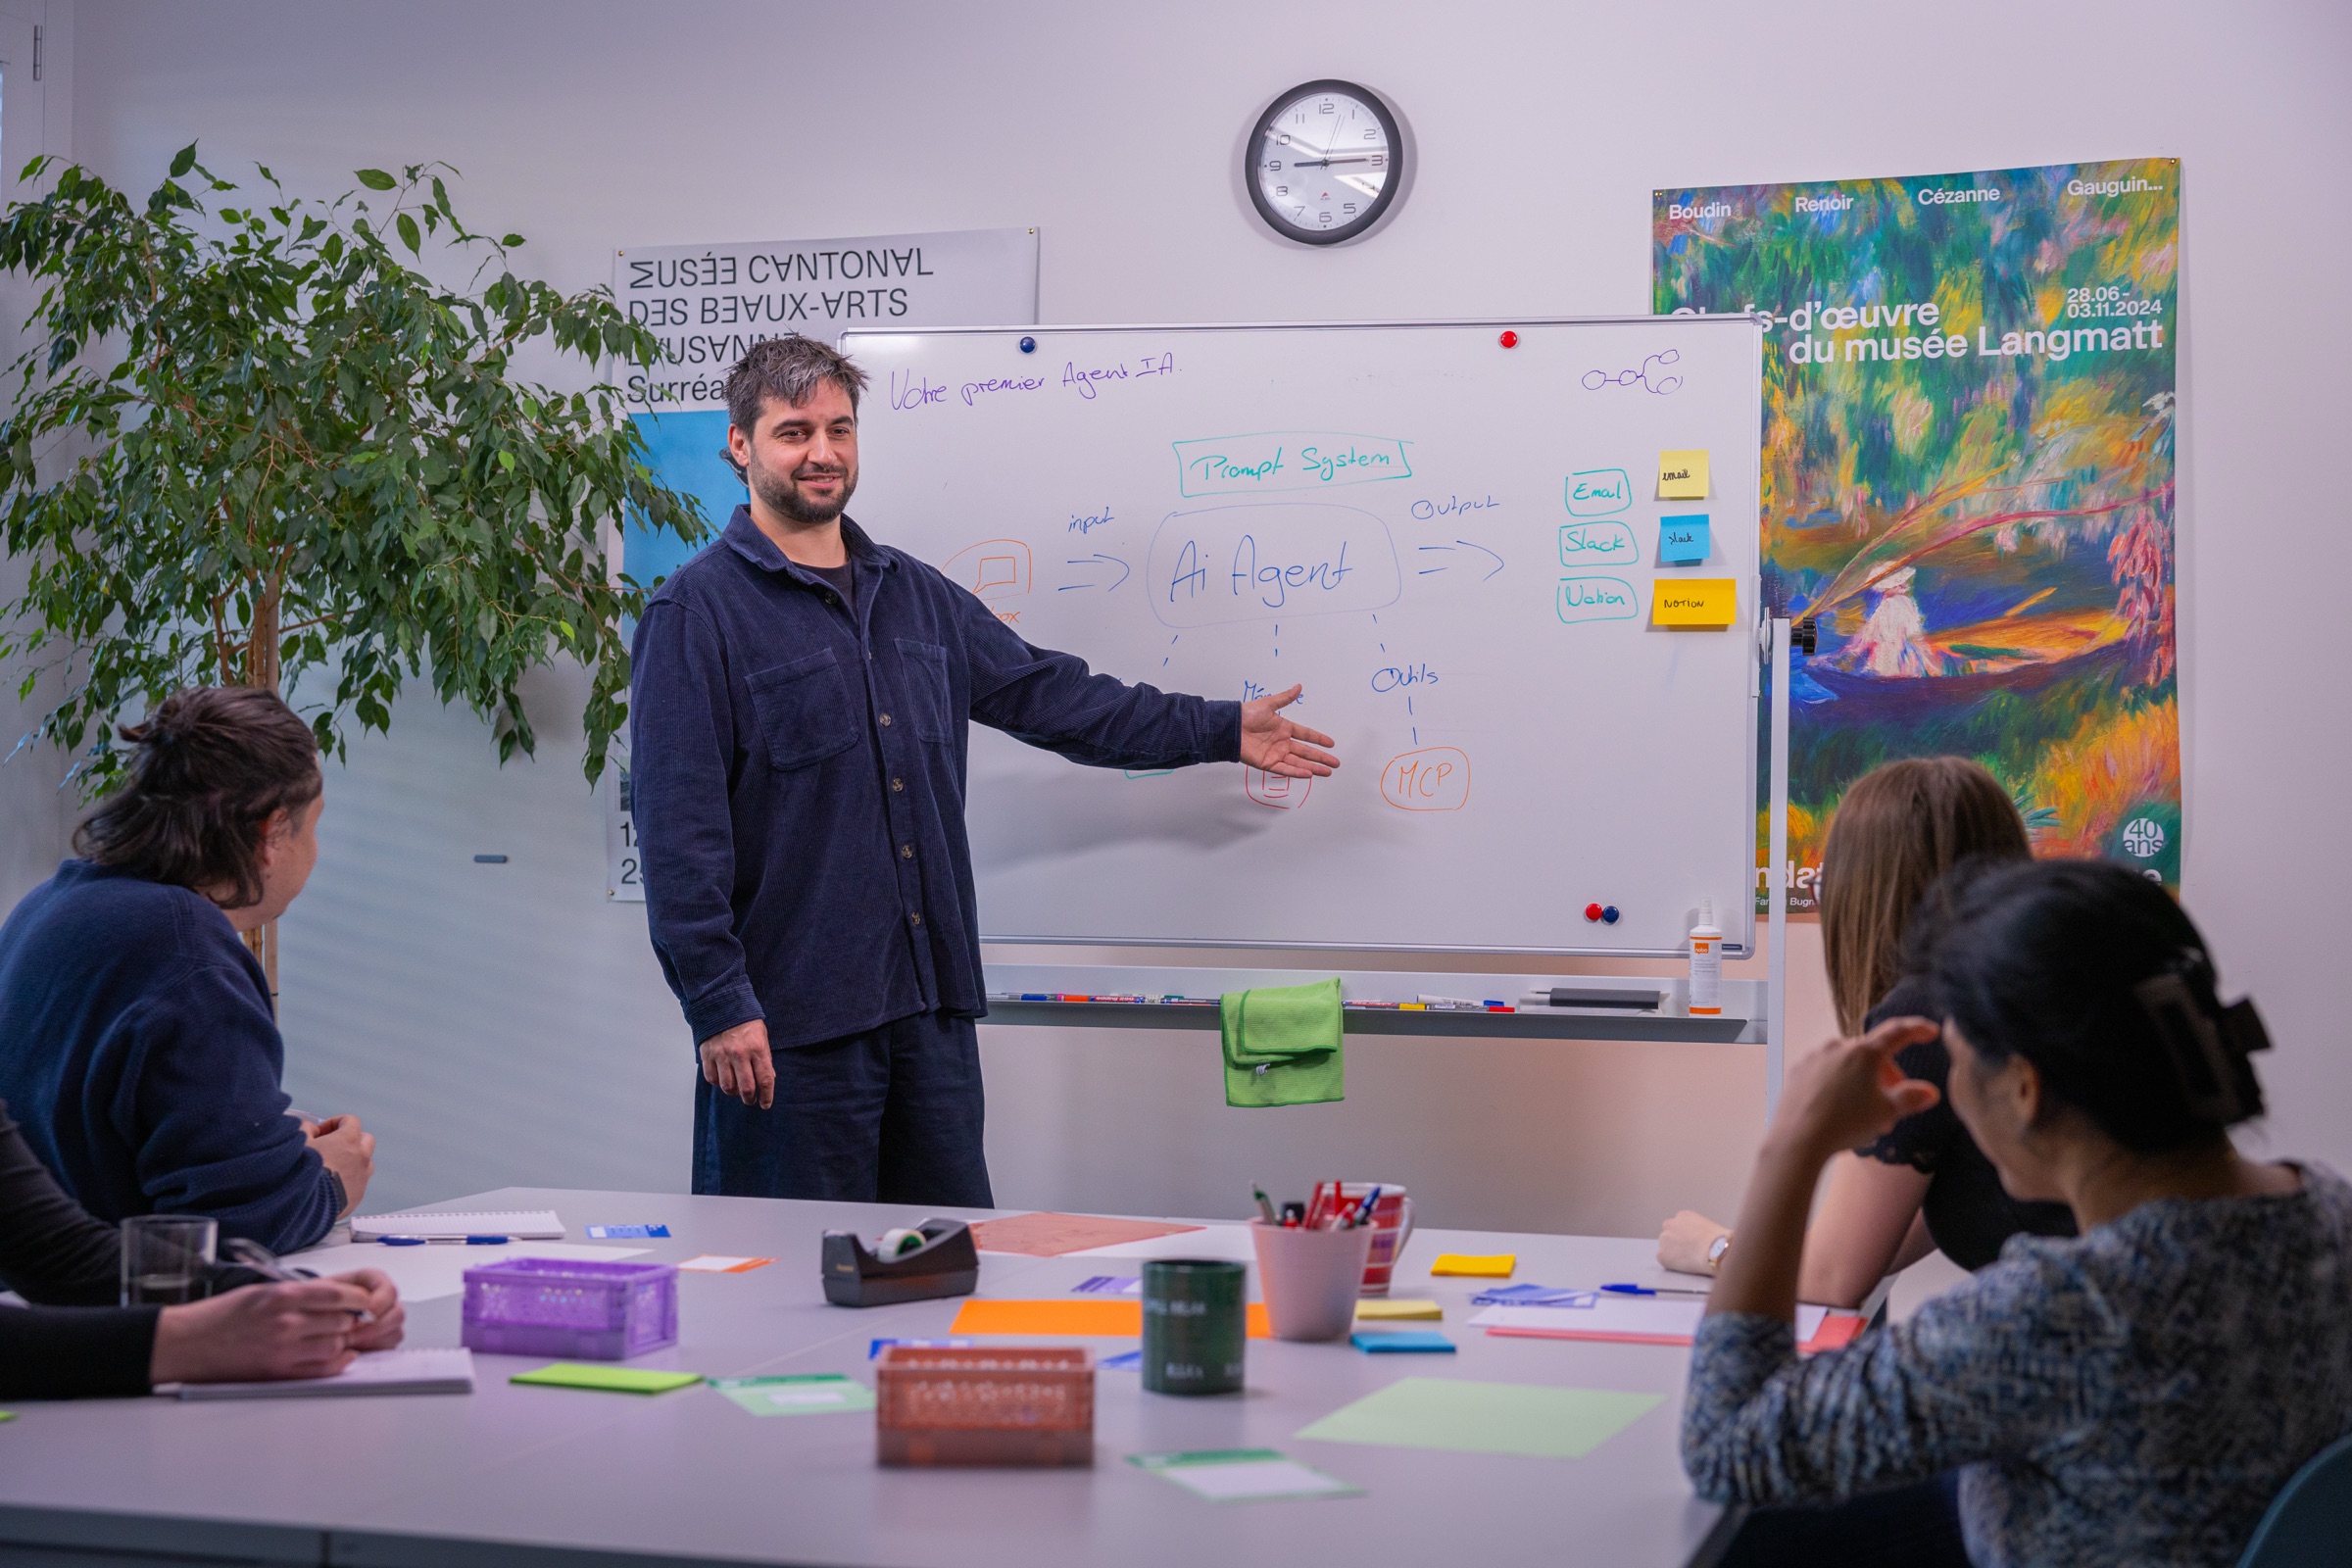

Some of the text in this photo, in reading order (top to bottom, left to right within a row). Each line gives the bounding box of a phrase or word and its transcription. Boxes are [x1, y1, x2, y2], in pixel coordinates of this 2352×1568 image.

[1296, 113, 1305, 124] 11
[1319, 103, 1335, 115] 12
[1276, 134, 1291, 146] 10
[1364, 128, 1377, 140] 2
[1269, 160, 1282, 172] 9
[1371, 154, 1384, 167] 3
[1276, 185, 1289, 197] 8
[1918, 186, 2000, 207] Cézanne
[1294, 206, 1306, 218] 7
[1343, 203, 1356, 215] 5
[1669, 202, 1732, 221] Boudin
[1794, 193, 1854, 214] Renoir
[1319, 212, 1333, 223] 6
[749, 247, 934, 284] CANTONAL
[628, 288, 908, 327] DES BEAUX-ARTS
[1671, 301, 1940, 333] s-d’œuvre
[2067, 299, 2163, 318] 03.11.2024
[1788, 318, 2163, 364] du musée Langmatt
[627, 373, 724, 403] Surréa
[891, 368, 948, 411] Votre
[960, 375, 1046, 407] premier
[1062, 362, 1128, 400] Agent
[1190, 446, 1391, 482] Prompt System
[1573, 480, 1622, 501] Email
[1410, 495, 1500, 520] Output
[1067, 506, 1115, 534] input
[1565, 528, 1626, 552] Slack
[1231, 534, 1353, 609] Agent
[1371, 663, 1439, 693] Outils
[1398, 760, 1453, 799] MCP
[619, 821, 637, 848] 1
[2129, 819, 2158, 839] 40
[2124, 838, 2164, 855] ans
